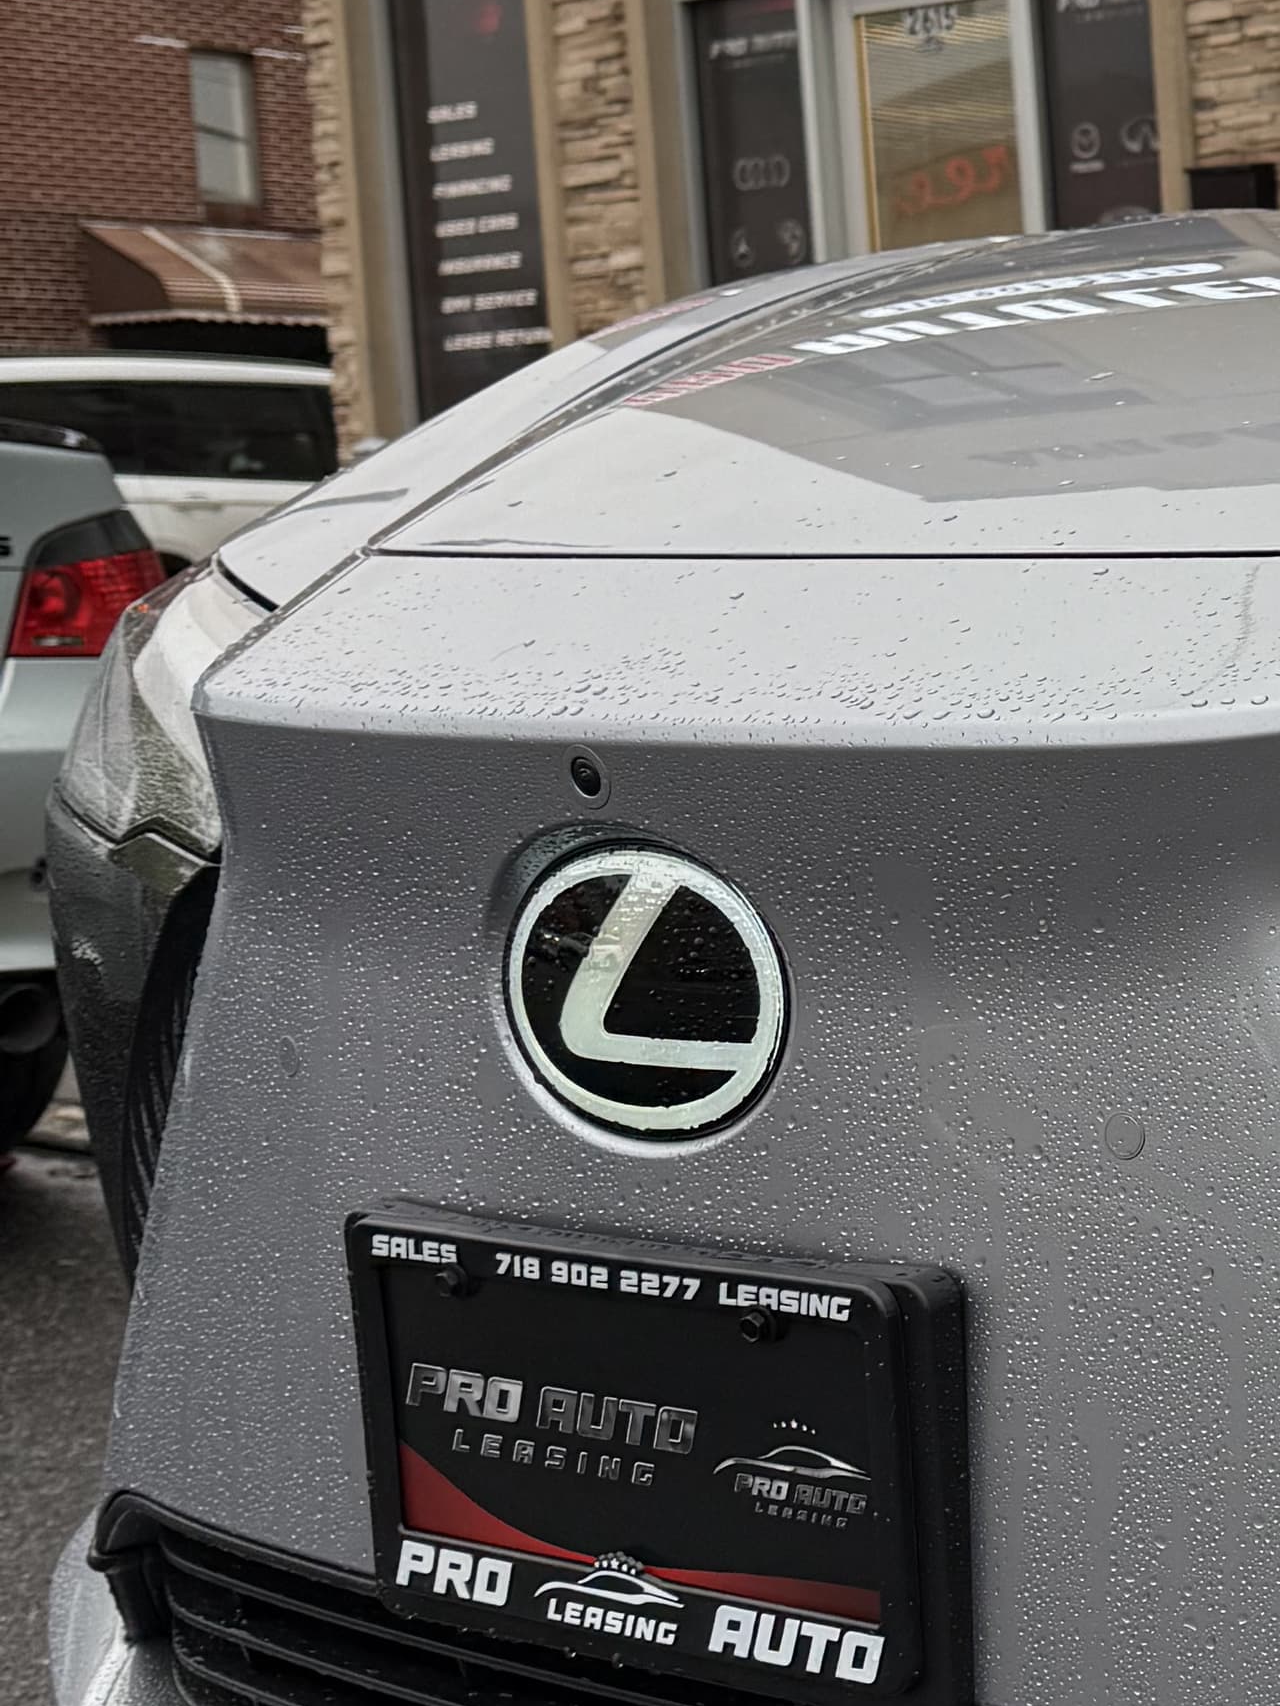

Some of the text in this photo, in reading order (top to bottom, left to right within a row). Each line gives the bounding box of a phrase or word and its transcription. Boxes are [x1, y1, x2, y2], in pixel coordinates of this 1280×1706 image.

[371, 1233, 852, 1322] SALES 718 902 2277 LEASING
[405, 1361, 699, 1456] PRO AUTO
[451, 1427, 657, 1487] LEASING
[733, 1472, 868, 1516] PRO AUTO
[753, 1500, 849, 1529] LEASING
[395, 1539, 885, 1685] PRO AUTO
[546, 1596, 679, 1647] LEASING
